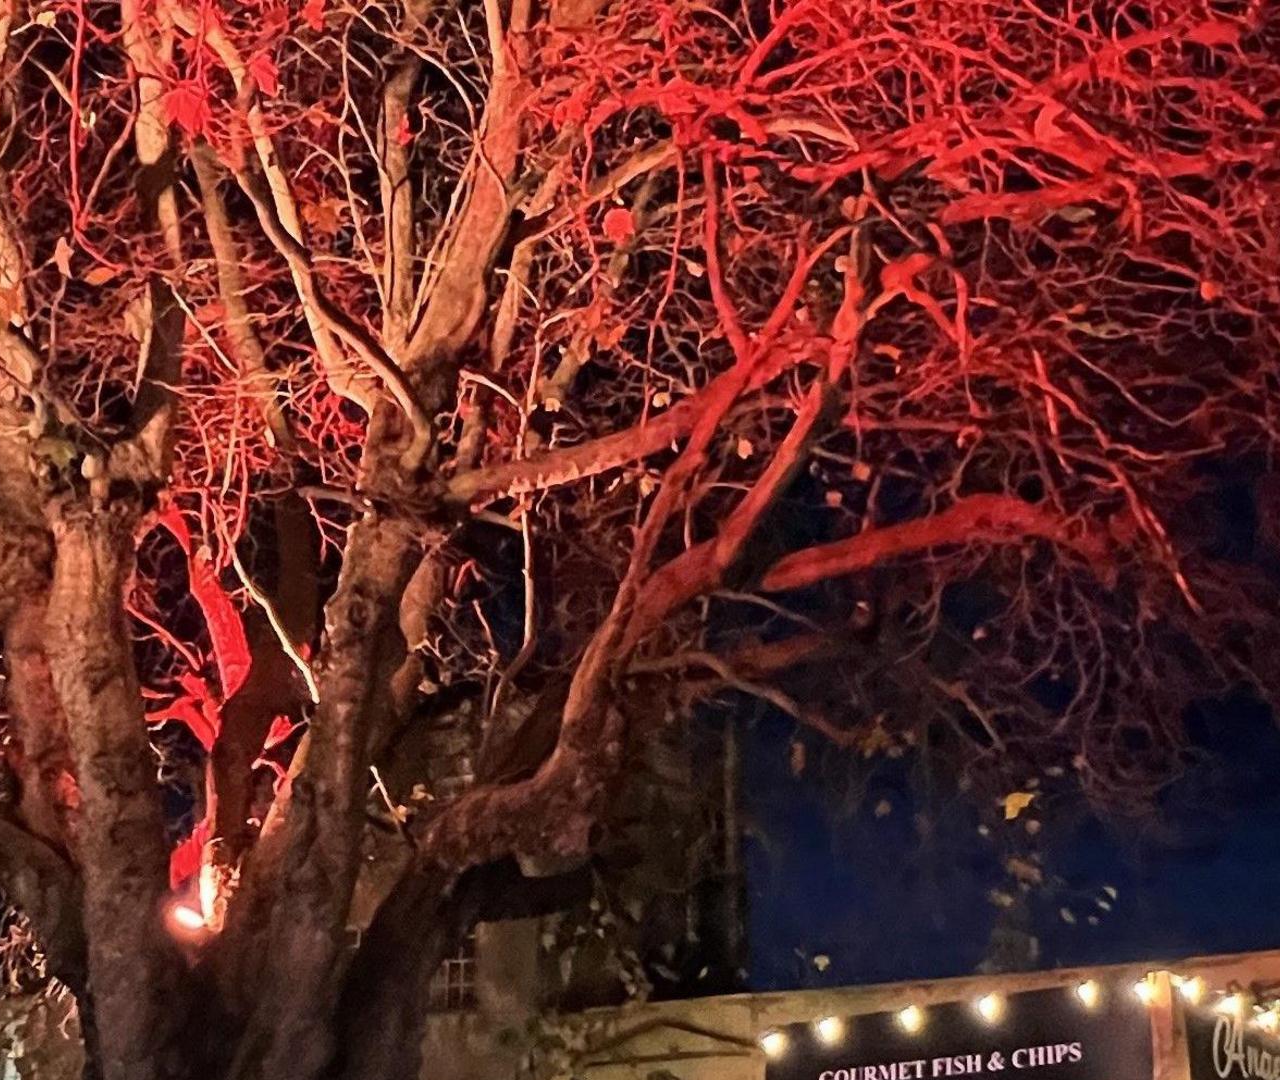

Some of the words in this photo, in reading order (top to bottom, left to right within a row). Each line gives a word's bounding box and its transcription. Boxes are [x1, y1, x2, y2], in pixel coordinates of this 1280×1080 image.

[932, 1054, 982, 1077] FISH
[987, 1051, 1005, 1071] &
[1012, 1042, 1082, 1068] CHIPS
